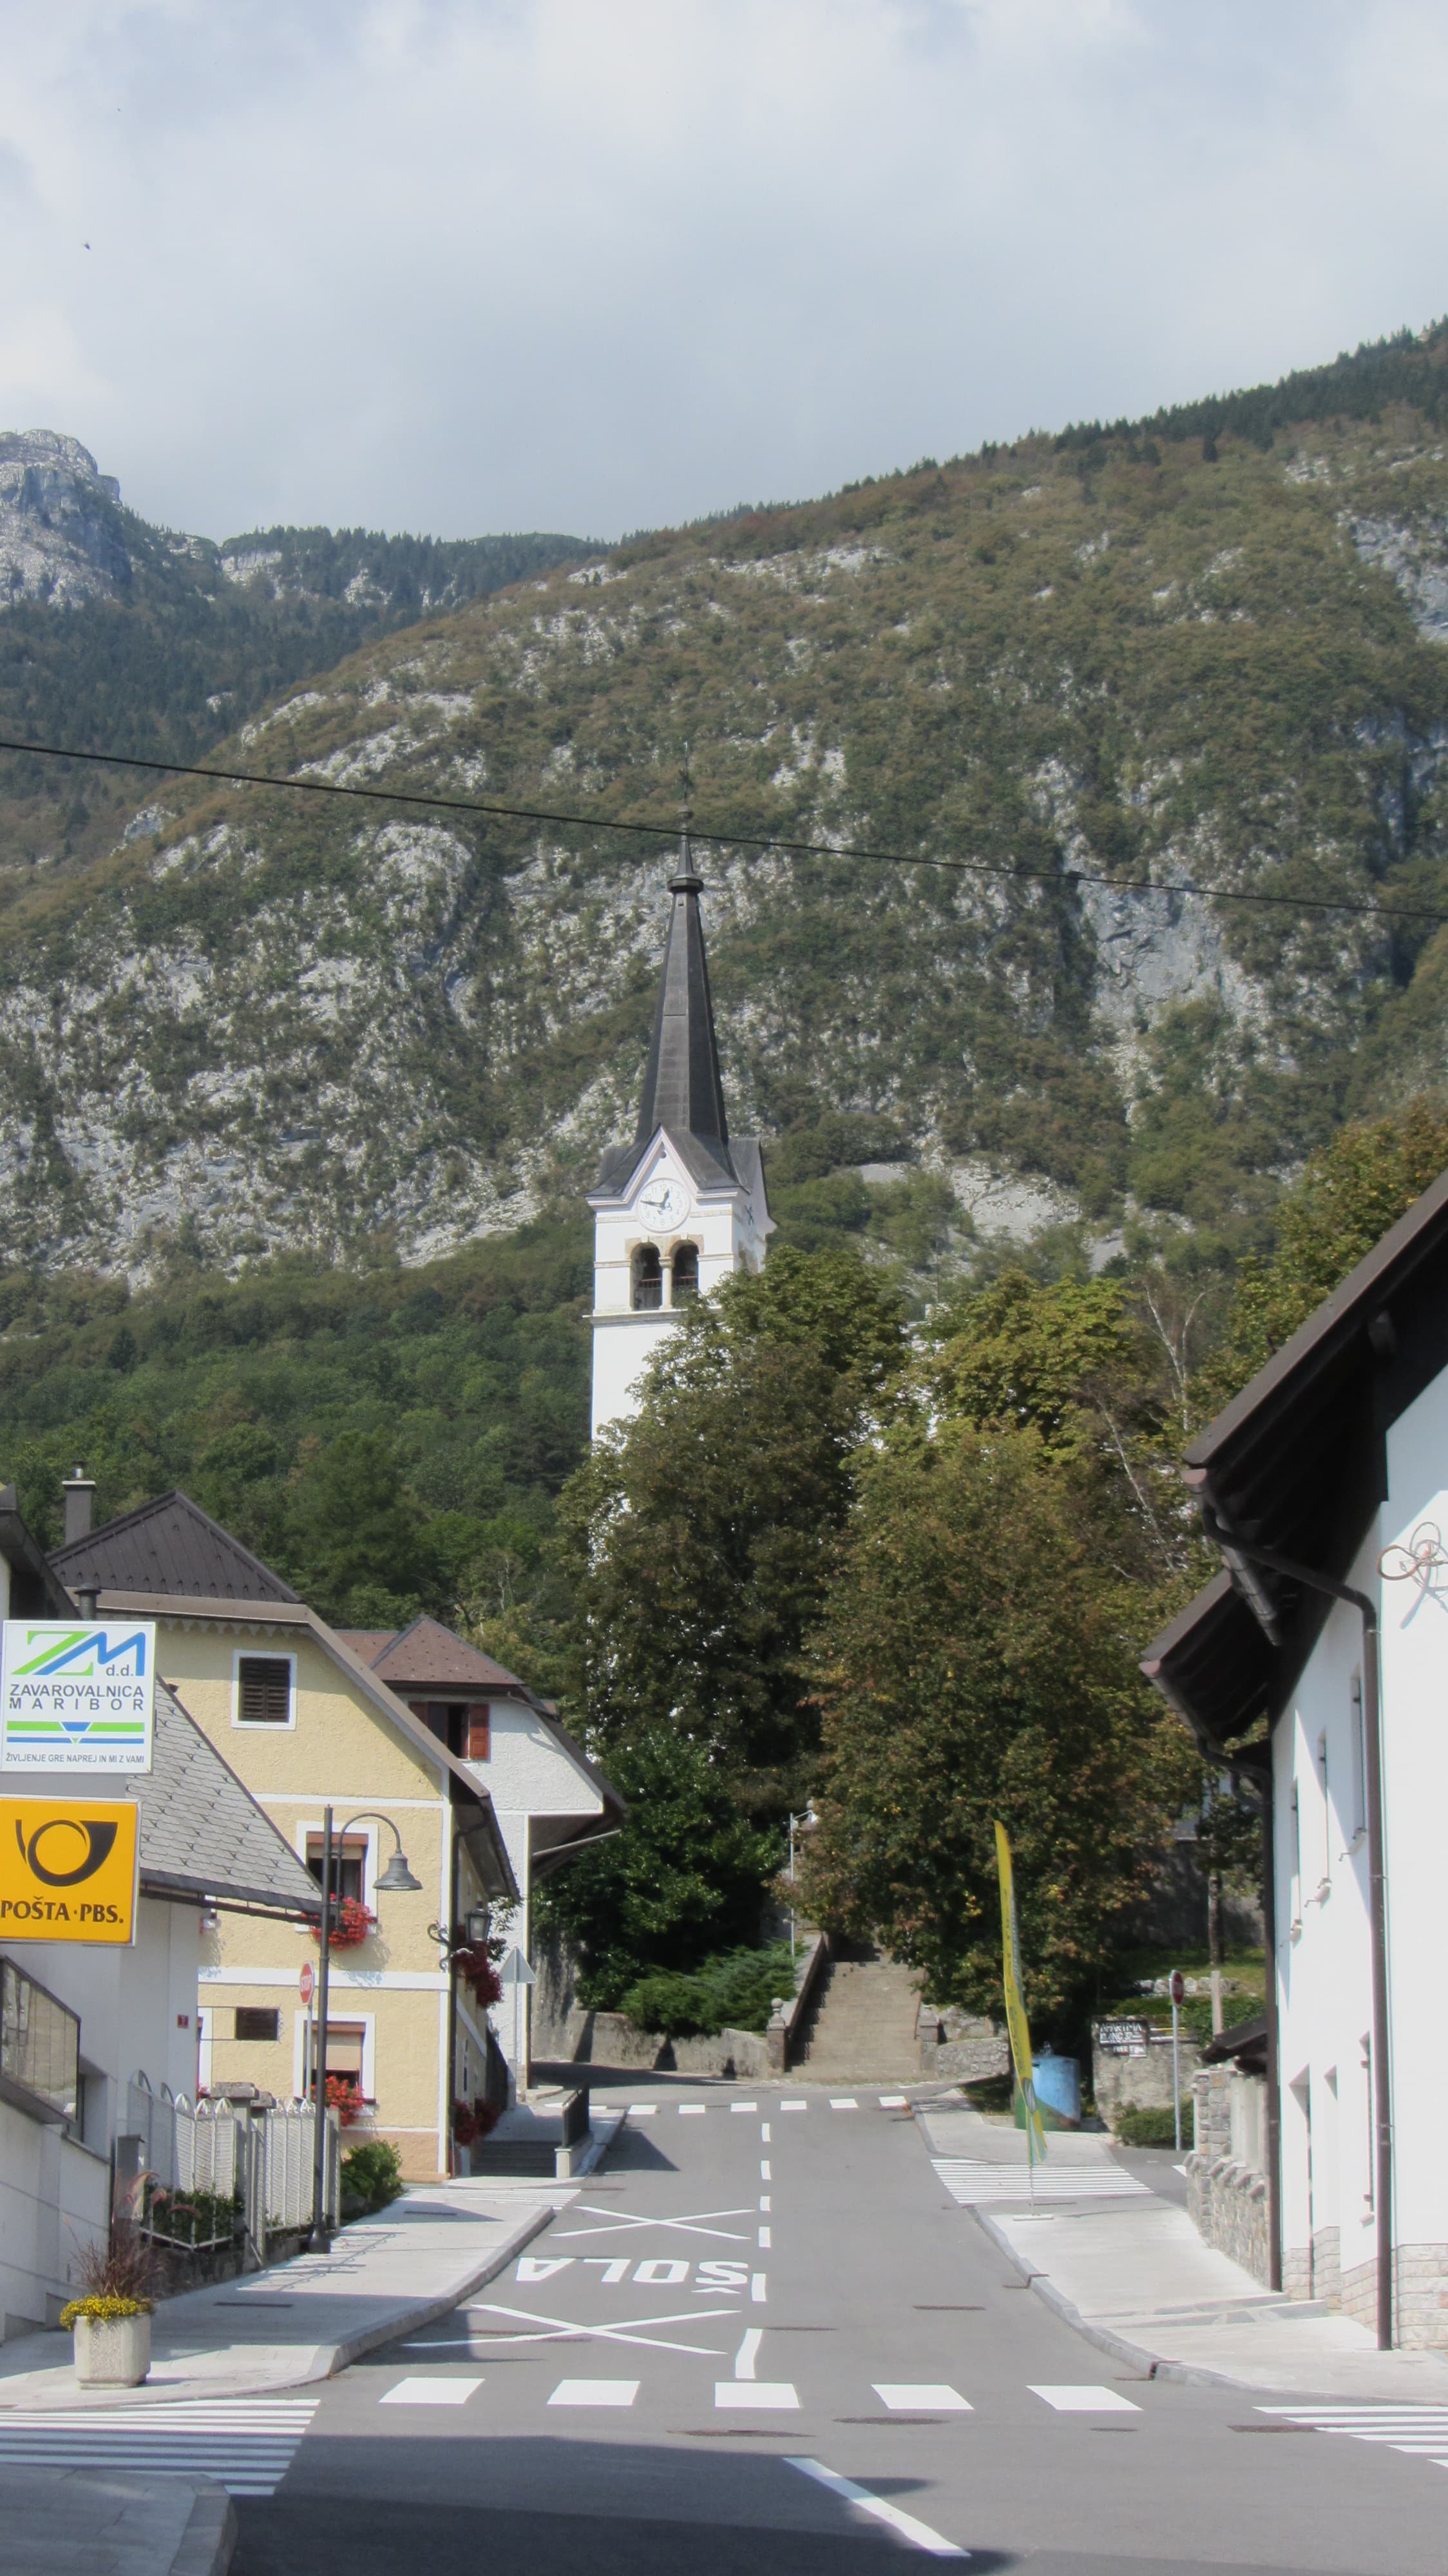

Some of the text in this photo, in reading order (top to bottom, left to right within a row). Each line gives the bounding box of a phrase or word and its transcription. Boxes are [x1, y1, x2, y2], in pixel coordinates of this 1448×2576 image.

[106, 1664, 134, 1676] d.d.
[10, 1684, 144, 1698] ZAVAROVALNICA
[9, 1697, 144, 1710] MARIBOR
[6, 1752, 46, 1763] ŽIVLJENJE
[48, 1754, 64, 1763] GRE
[66, 1754, 97, 1763] NAPREJ
[99, 1755, 107, 1763] IN
[108, 1755, 117, 1763] MI
[0, 1896, 124, 1924] POŠTA PBS.
[301, 1975, 312, 1992] STOP
[516, 2257, 749, 2294] ŠOLA
